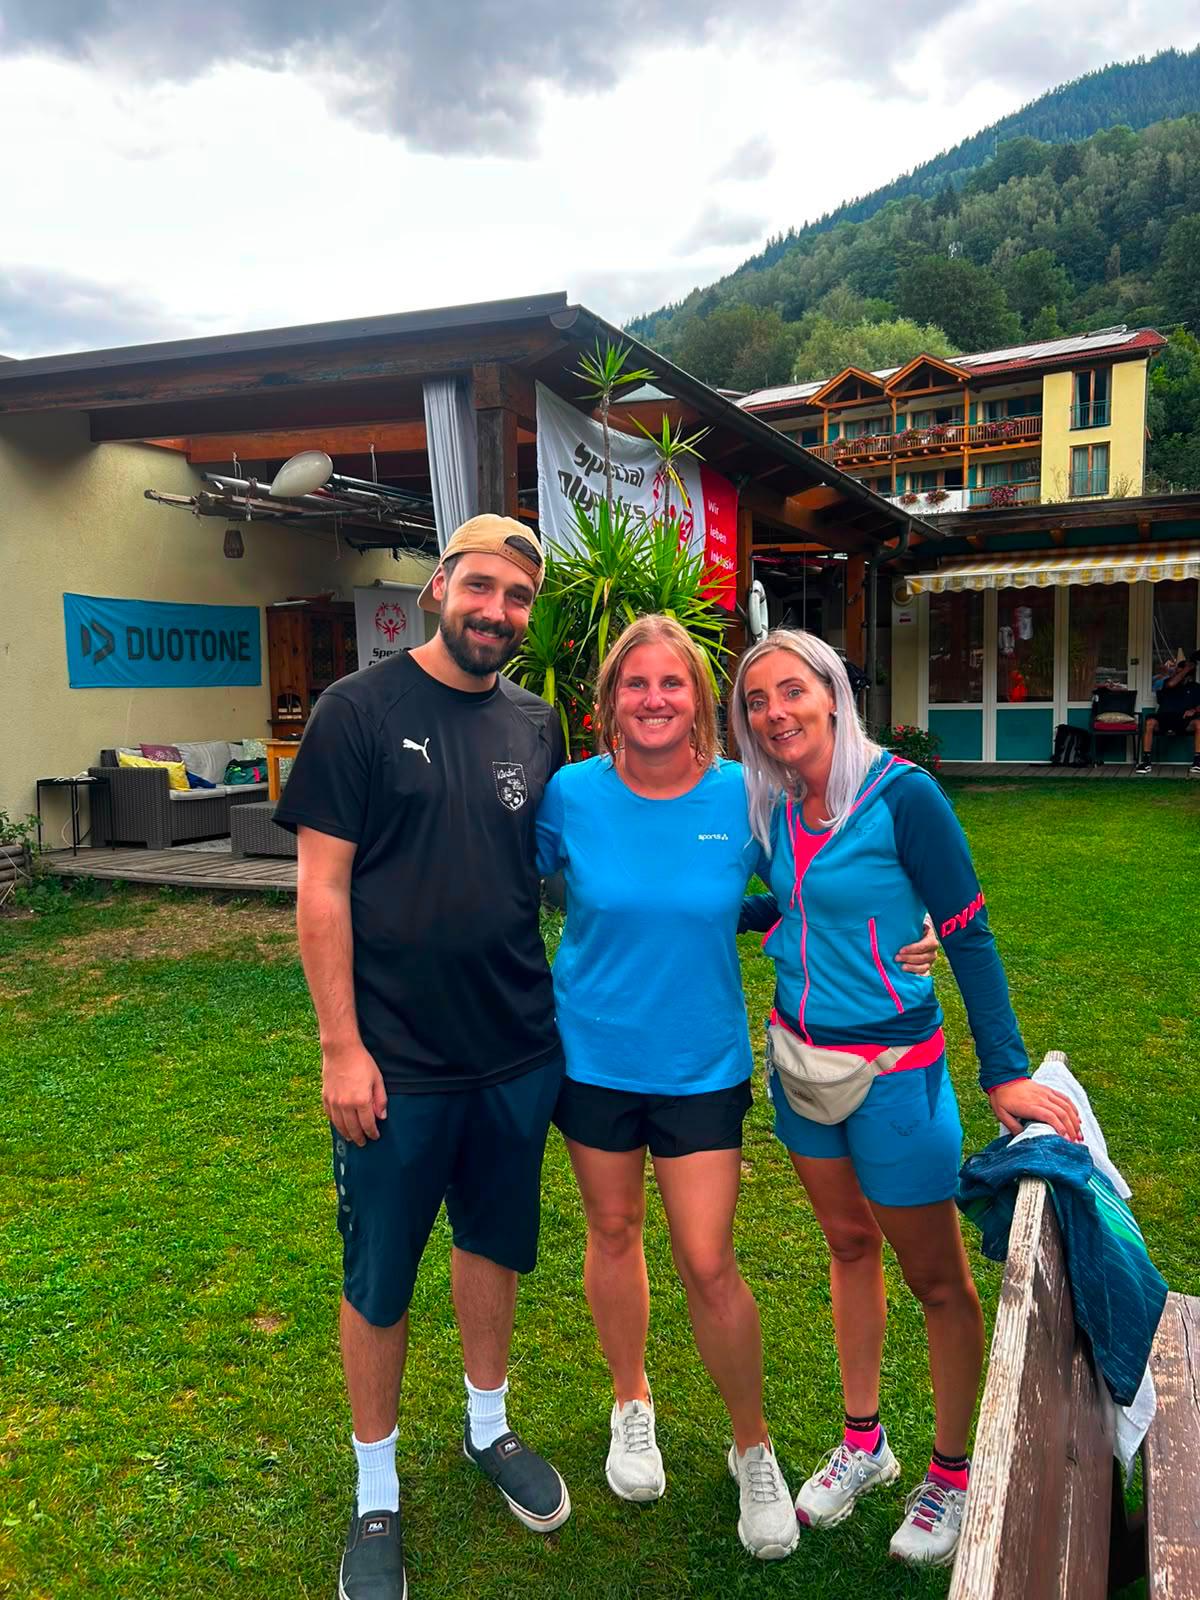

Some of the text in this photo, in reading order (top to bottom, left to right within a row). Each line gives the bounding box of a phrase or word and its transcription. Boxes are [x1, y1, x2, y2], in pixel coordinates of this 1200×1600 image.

[557, 470, 647, 521] Olypics
[708, 499, 719, 515] Wir
[126, 625, 252, 662] DUOTONE
